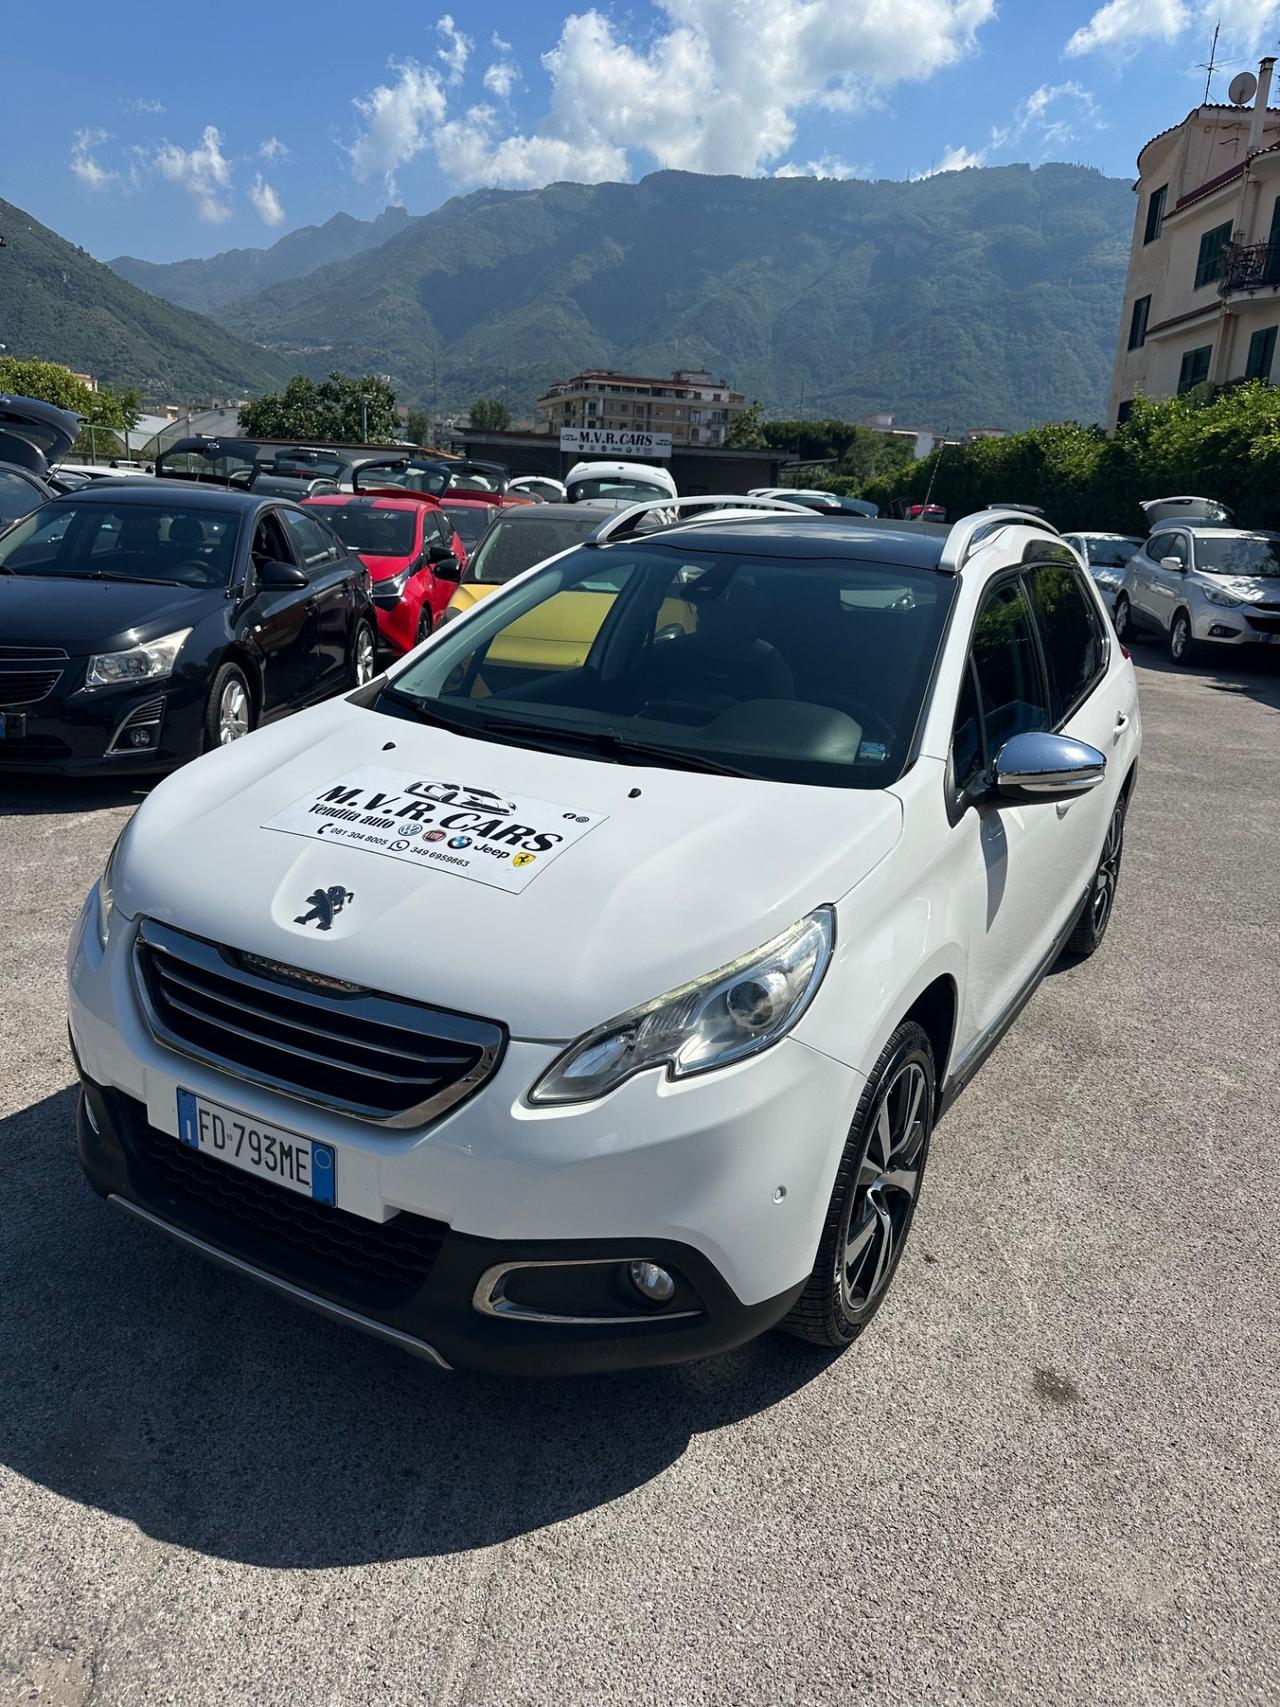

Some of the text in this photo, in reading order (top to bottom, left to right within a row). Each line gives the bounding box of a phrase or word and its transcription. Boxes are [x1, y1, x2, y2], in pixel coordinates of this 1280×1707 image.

[308, 803, 395, 829] Vendita auto
[410, 846, 470, 867] 349 6959863
[474, 843, 510, 859] Jeep
